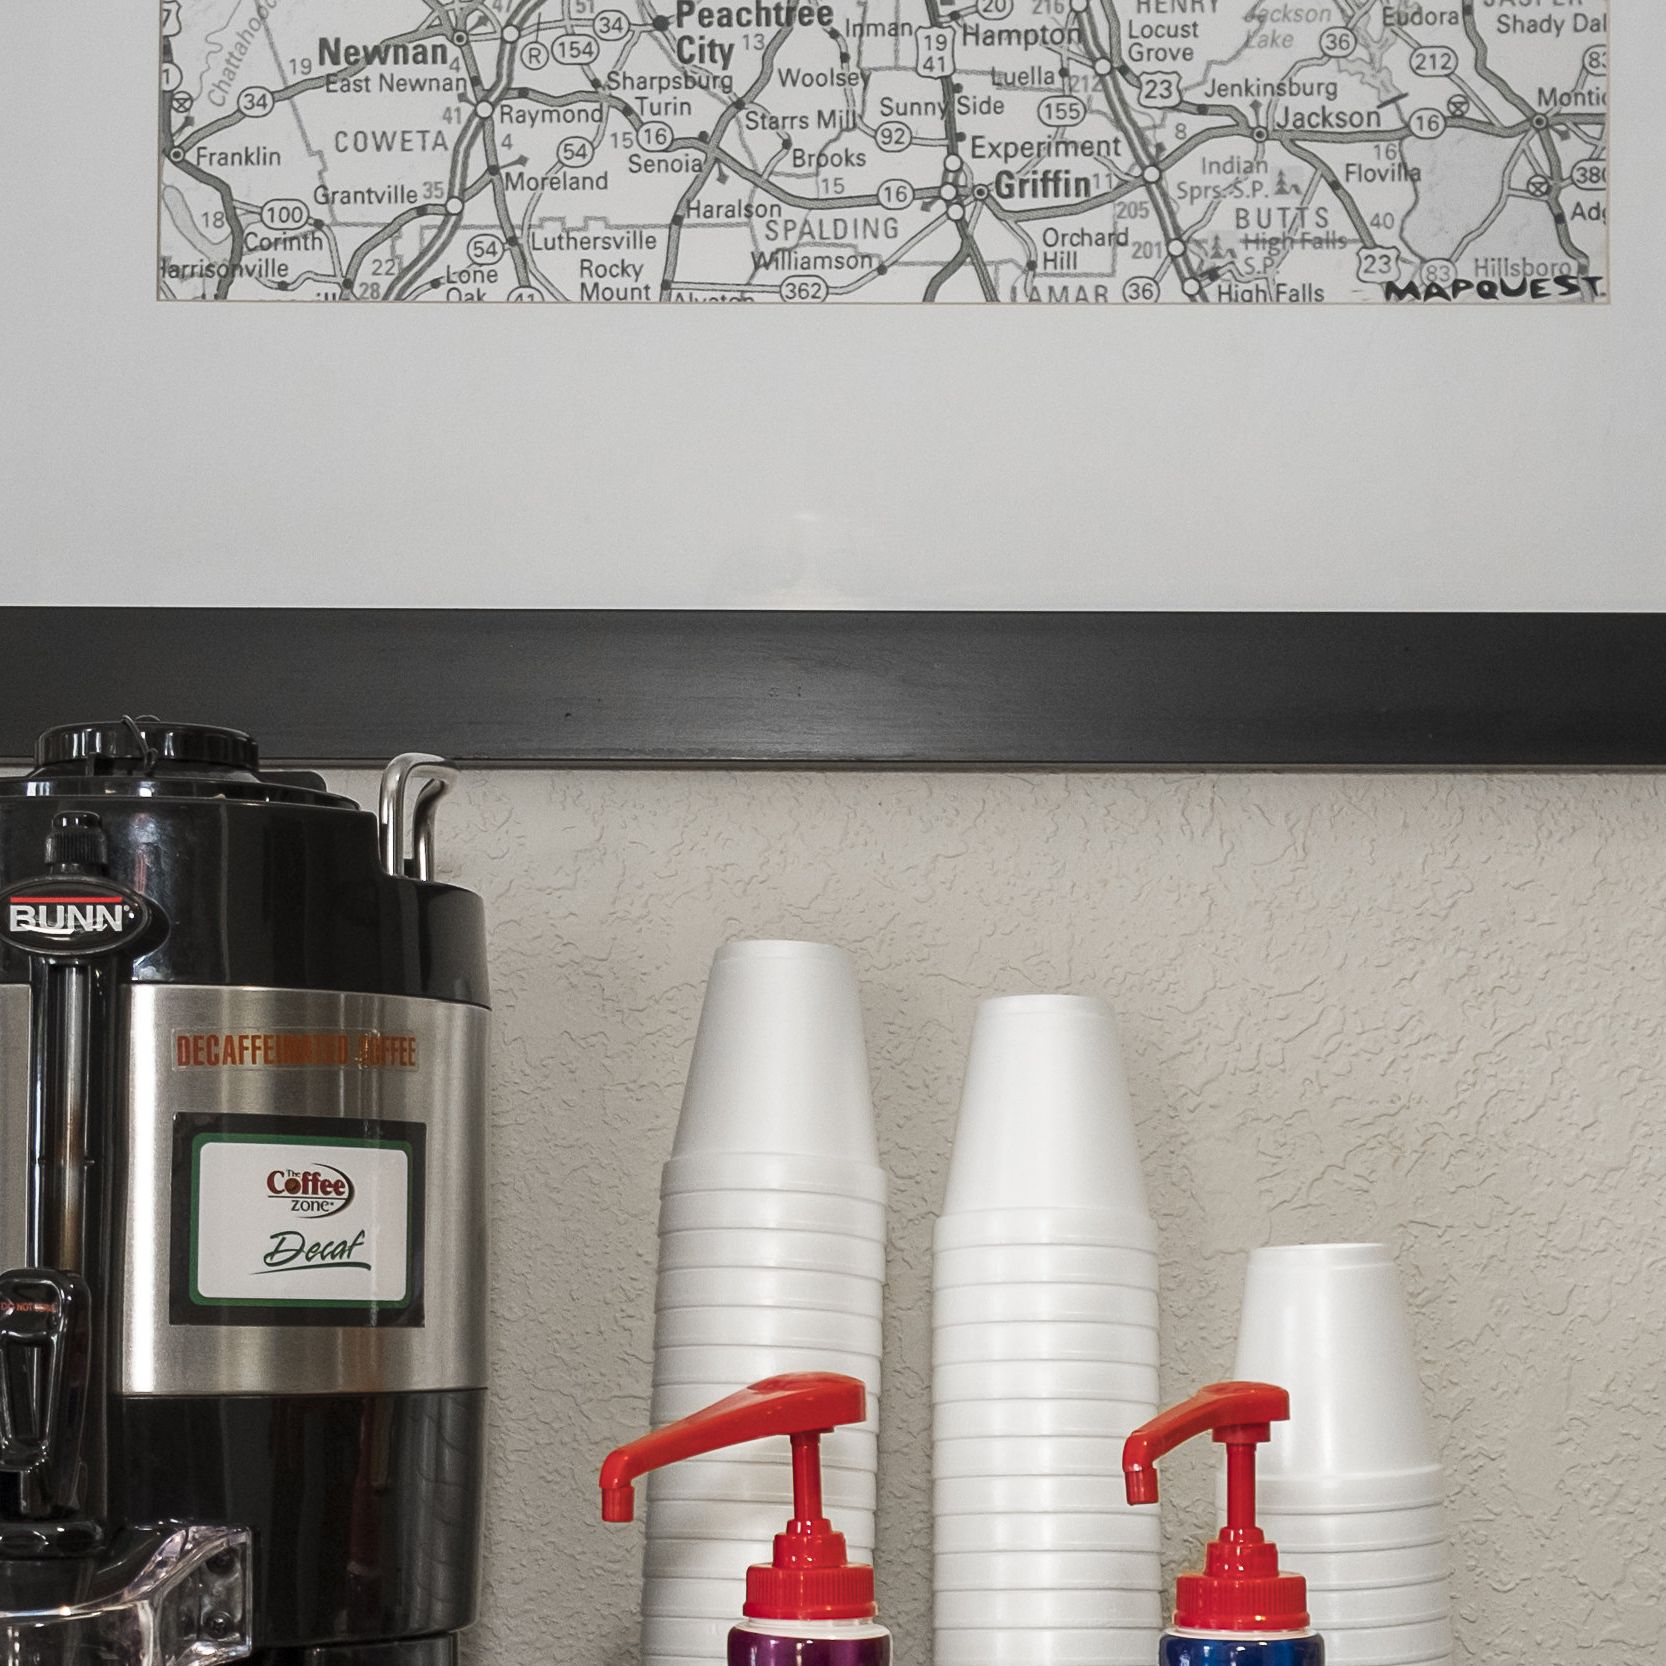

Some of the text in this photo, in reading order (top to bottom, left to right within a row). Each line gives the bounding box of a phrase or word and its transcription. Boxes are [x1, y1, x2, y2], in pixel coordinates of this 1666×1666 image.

[677, 2, 833, 28] Peachtree
[1244, 4, 1332, 24] Jackson
[1383, 7, 1460, 27] Eudora
[599, 16, 623, 34] 34
[845, 18, 913, 38] Inman
[1128, 20, 1200, 39] Locust
[1497, 13, 1565, 38] Shady
[743, 34, 765, 51] 13
[924, 34, 948, 51] 19
[963, 23, 1083, 51] Hampton
[1245, 29, 1294, 49] Lake
[1325, 34, 1350, 51] 36
[319, 37, 448, 65] Newnan
[529, 48, 541, 64] R
[559, 41, 594, 59] 154
[677, 35, 734, 70] City
[1128, 42, 1195, 62] Grove
[289, 58, 312, 75] 19
[449, 57, 460, 73] 4
[923, 56, 946, 73] 41
[1415, 53, 1452, 71] 212
[325, 73, 467, 93] East Newnan
[607, 71, 733, 94] Sharpsburg
[992, 66, 1055, 87] Luella
[1145, 79, 1173, 99] 23
[1204, 79, 1338, 100] Jenkinsburg
[243, 93, 268, 110] 34
[635, 97, 692, 116] Turin
[880, 97, 1004, 121] Sunny Side
[442, 107, 462, 125] 41
[500, 105, 603, 128] Raymond
[746, 110, 856, 131] Starrs Mill
[1045, 103, 1080, 120] 155
[1276, 106, 1381, 129] Jackson
[1175, 123, 1187, 140] 8
[1416, 115, 1440, 132] 16
[335, 131, 449, 153] COWETA
[501, 133, 513, 149] 4
[611, 132, 633, 149] 15
[645, 128, 667, 144] 16
[881, 128, 905, 145] 92
[197, 147, 281, 166] Franklin
[563, 143, 587, 160] 54
[793, 149, 866, 168] Brooks
[971, 136, 1121, 164] Experiment
[1374, 144, 1397, 161] 16
[629, 153, 702, 174] Senoia
[1202, 157, 1268, 175] Indian
[1346, 163, 1421, 182] Flovilla
[423, 181, 444, 199] 35
[505, 171, 608, 191] Moreland
[822, 178, 845, 195] 15
[995, 169, 1091, 199] Griffin
[1093, 172, 1113, 189] 11
[314, 185, 418, 205] Grantville
[884, 186, 907, 203] 16
[1234, 181, 1269, 200] S.P.
[267, 206, 303, 223] 100
[687, 199, 782, 219] Haralson
[1117, 202, 1150, 219] 205
[1236, 207, 1329, 229] BUTTS
[202, 211, 225, 228] 18
[1370, 213, 1394, 229] 40
[765, 218, 899, 241] SPALDING
[1043, 228, 1129, 247] Orchard
[244, 232, 323, 251] Corinth
[473, 242, 497, 259] 54
[532, 231, 657, 251] Luthersville
[1132, 241, 1162, 259] 201
[372, 259, 395, 276] 22
[580, 258, 644, 281] Rocky
[751, 251, 873, 271] Williamson
[1043, 251, 1077, 270] Hill
[1245, 256, 1280, 275] S.P.
[1364, 255, 1392, 274] 23
[1475, 258, 1572, 278] Hillsboro
[447, 265, 498, 285] Lone
[1426, 266, 1450, 283] 83
[358, 283, 380, 300] 28
[581, 282, 651, 301] Mount
[785, 282, 822, 300] 362
[1129, 283, 1153, 300] 36
[1218, 283, 1324, 302] High Falls
[10, 904, 123, 932] BUNN
[267, 1170, 346, 1196] Coffee
[263, 1229, 365, 1268] Decaf
